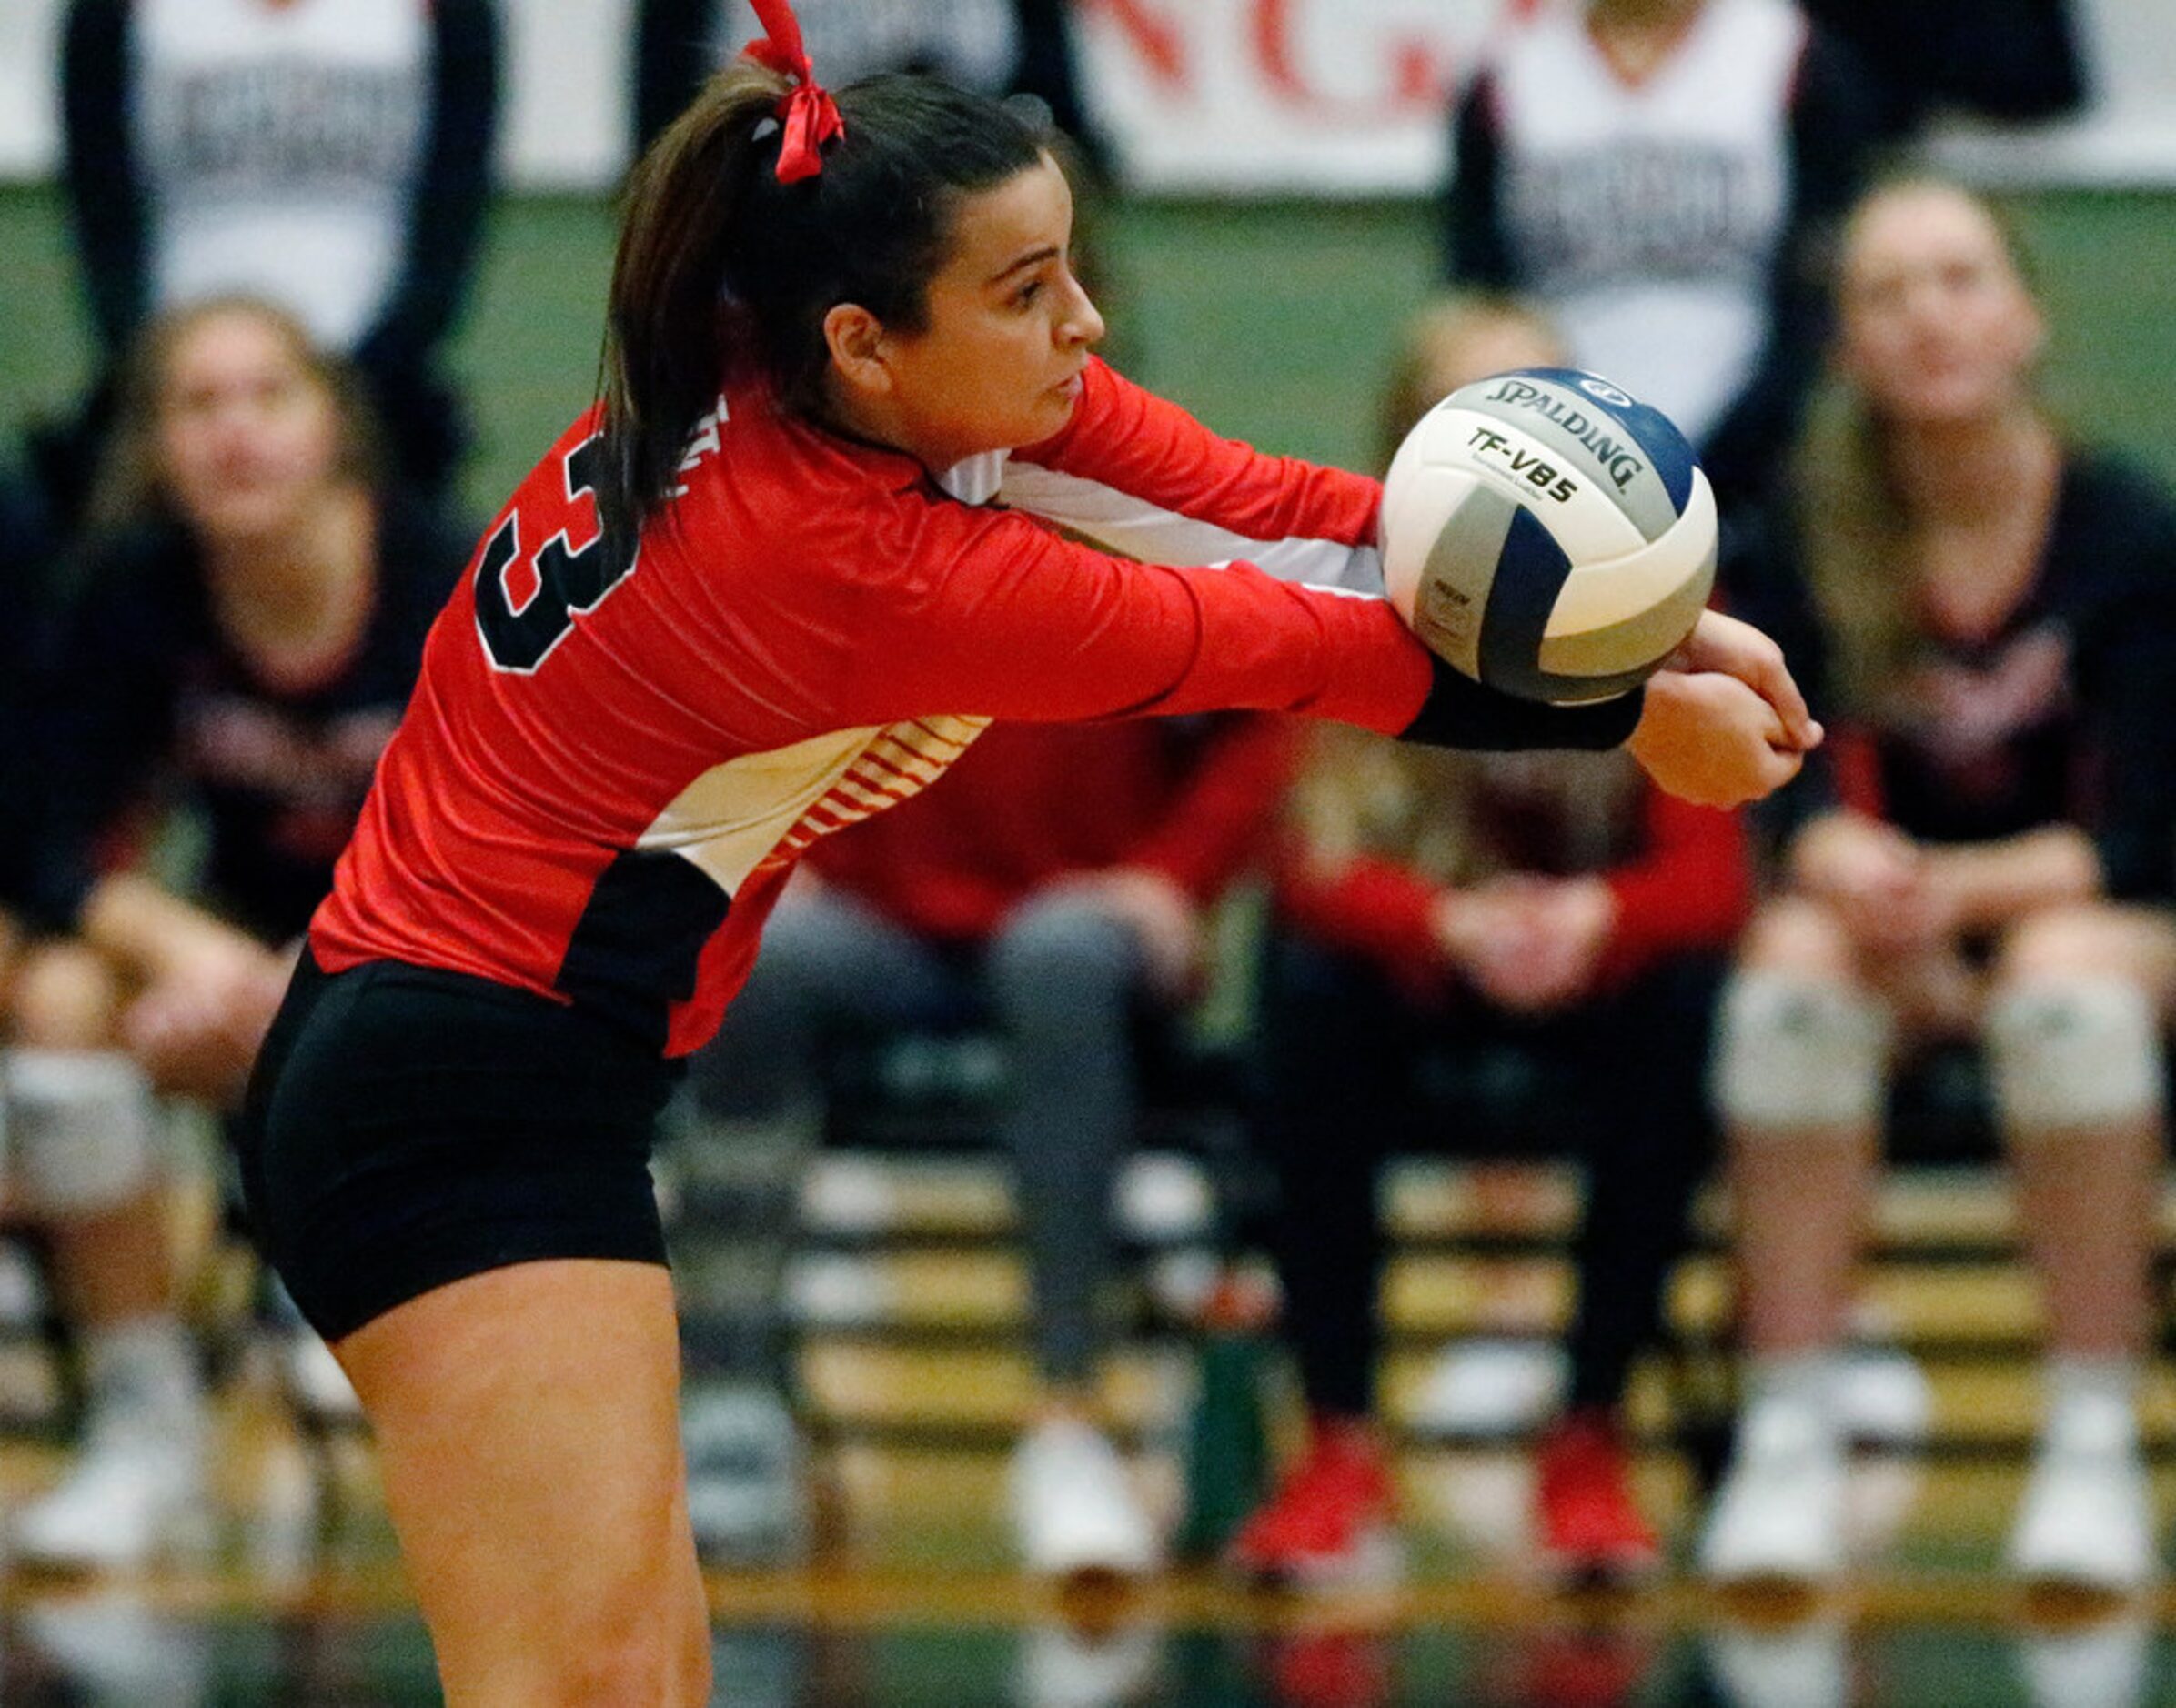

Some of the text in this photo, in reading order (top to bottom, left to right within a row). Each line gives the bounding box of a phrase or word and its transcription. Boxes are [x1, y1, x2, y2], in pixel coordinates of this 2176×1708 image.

[1468, 427, 1578, 503] TF-VB5
[1486, 380, 1643, 491] SPALDING
[473, 430, 640, 676] 3
